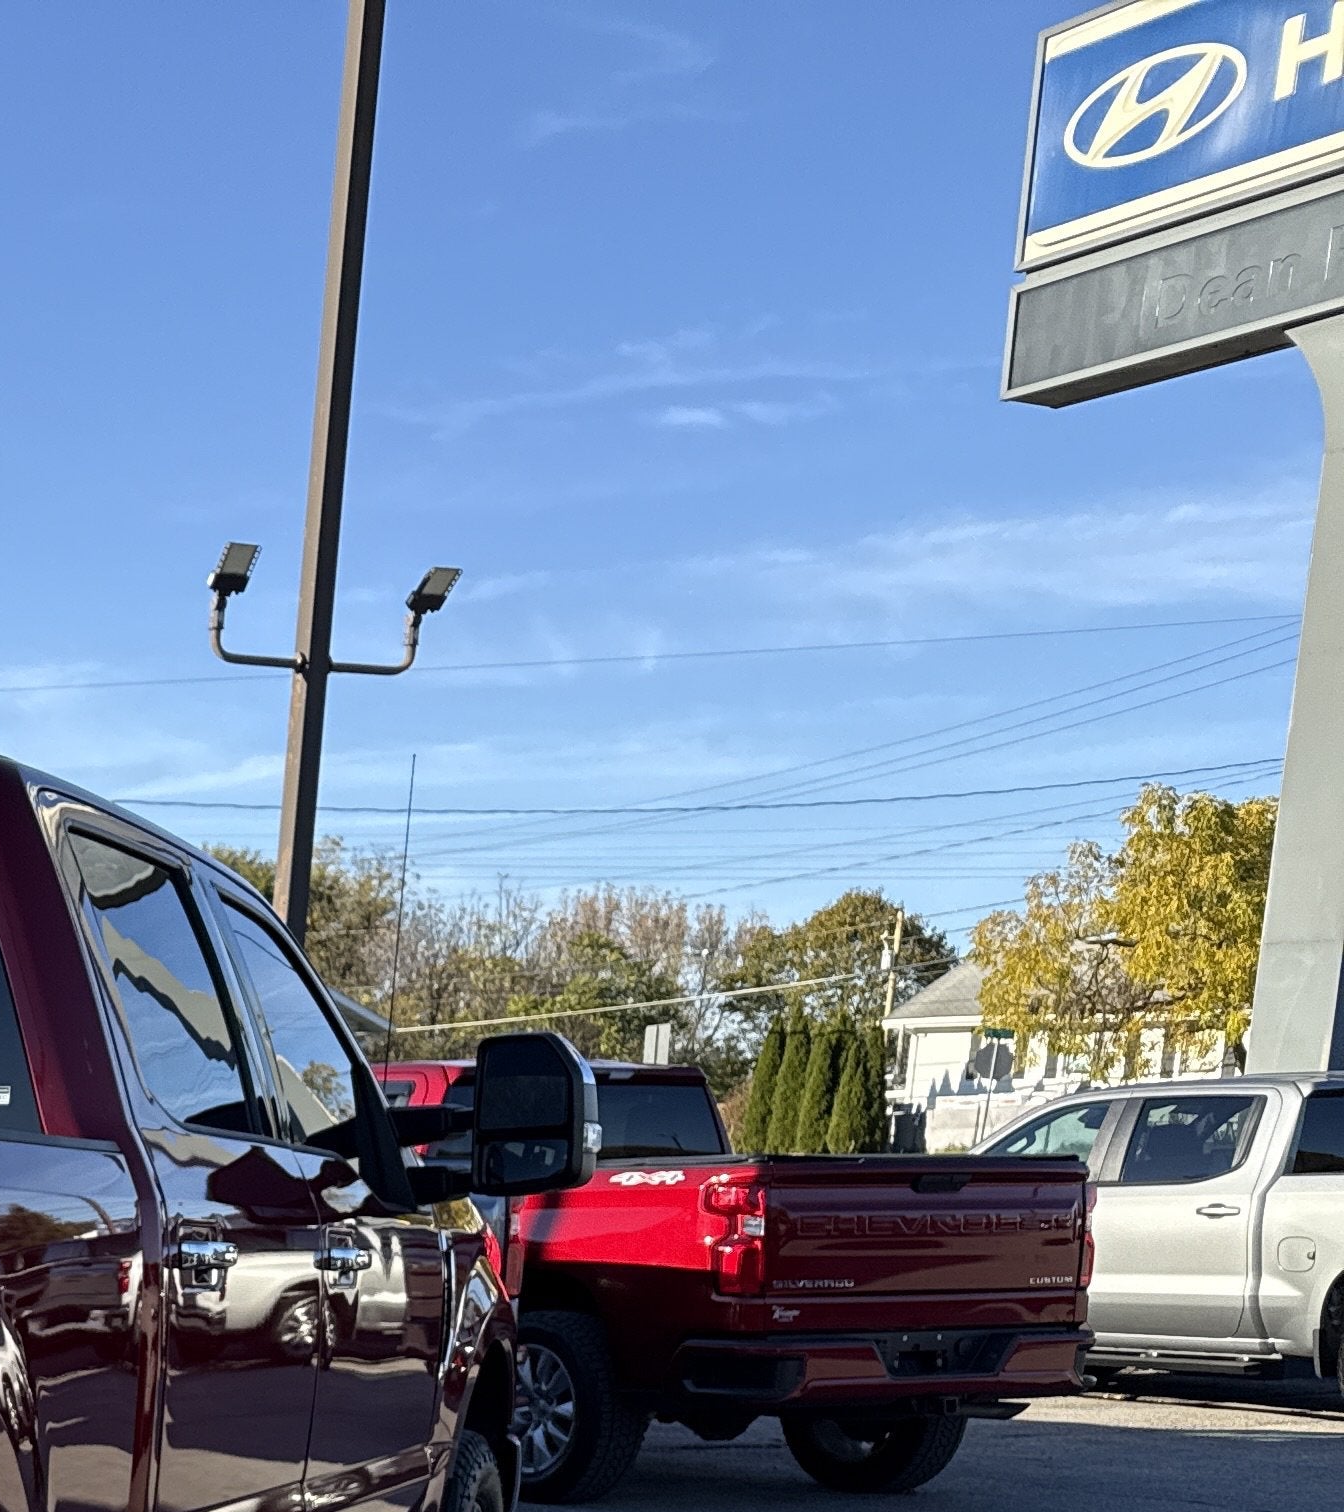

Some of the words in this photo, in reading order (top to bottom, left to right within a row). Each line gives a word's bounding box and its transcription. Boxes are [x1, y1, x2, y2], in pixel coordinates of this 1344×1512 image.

[796, 1213, 1074, 1236] CHEVROLET
[772, 1279, 854, 1288] SILVERADO
[1029, 1275, 1073, 1285] CUSTOM
